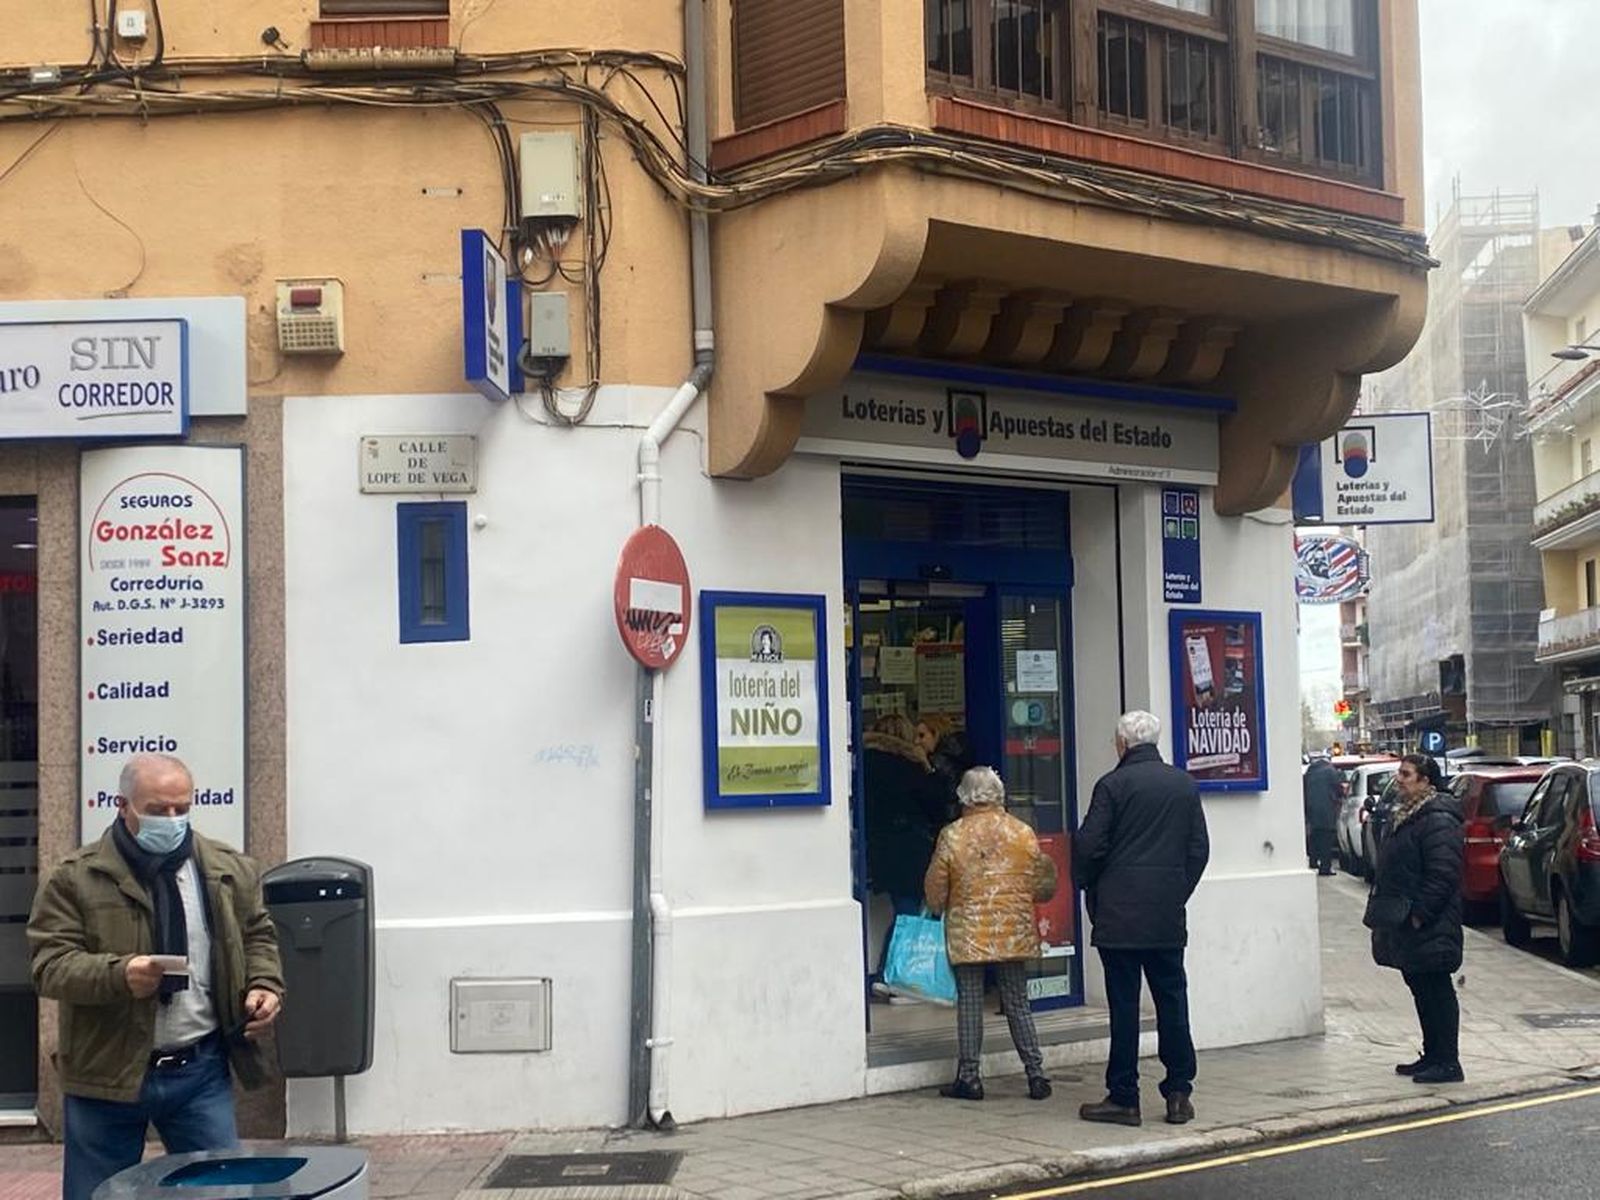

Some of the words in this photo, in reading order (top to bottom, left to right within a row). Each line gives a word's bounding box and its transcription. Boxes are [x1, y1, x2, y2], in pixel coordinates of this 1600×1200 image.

[70, 336, 161, 371] SIN
[58, 382, 174, 408] CORREDOR
[933, 409, 944, 433] y
[990, 411, 1075, 440] Apuestas
[1080, 418, 1107, 442] del
[1113, 422, 1172, 448] Estado
[399, 442, 447, 453] CALLE
[408, 458, 428, 469] DE
[367, 472, 401, 484] LOPE
[408, 472, 426, 484] DE
[432, 472, 468, 484] VEGA
[1383, 482, 1390, 491] y
[121, 495, 193, 508] SEGUROS
[1337, 493, 1387, 504] Apuestas
[1336, 504, 1374, 515] Estado
[96, 517, 213, 542] González
[161, 545, 225, 566] Sanz
[110, 575, 203, 591] Correduría
[118, 599, 156, 610] D.G.S.
[97, 627, 183, 646] Seriedad
[97, 681, 169, 700] Calidad
[729, 670, 776, 698] lotería
[781, 670, 800, 698] del
[731, 702, 802, 736] NIÑO
[1233, 705, 1246, 727] de
[97, 736, 177, 754] Servicio
[1189, 728, 1250, 753] NAVIDAD
[1429, 732, 1441, 750] P
